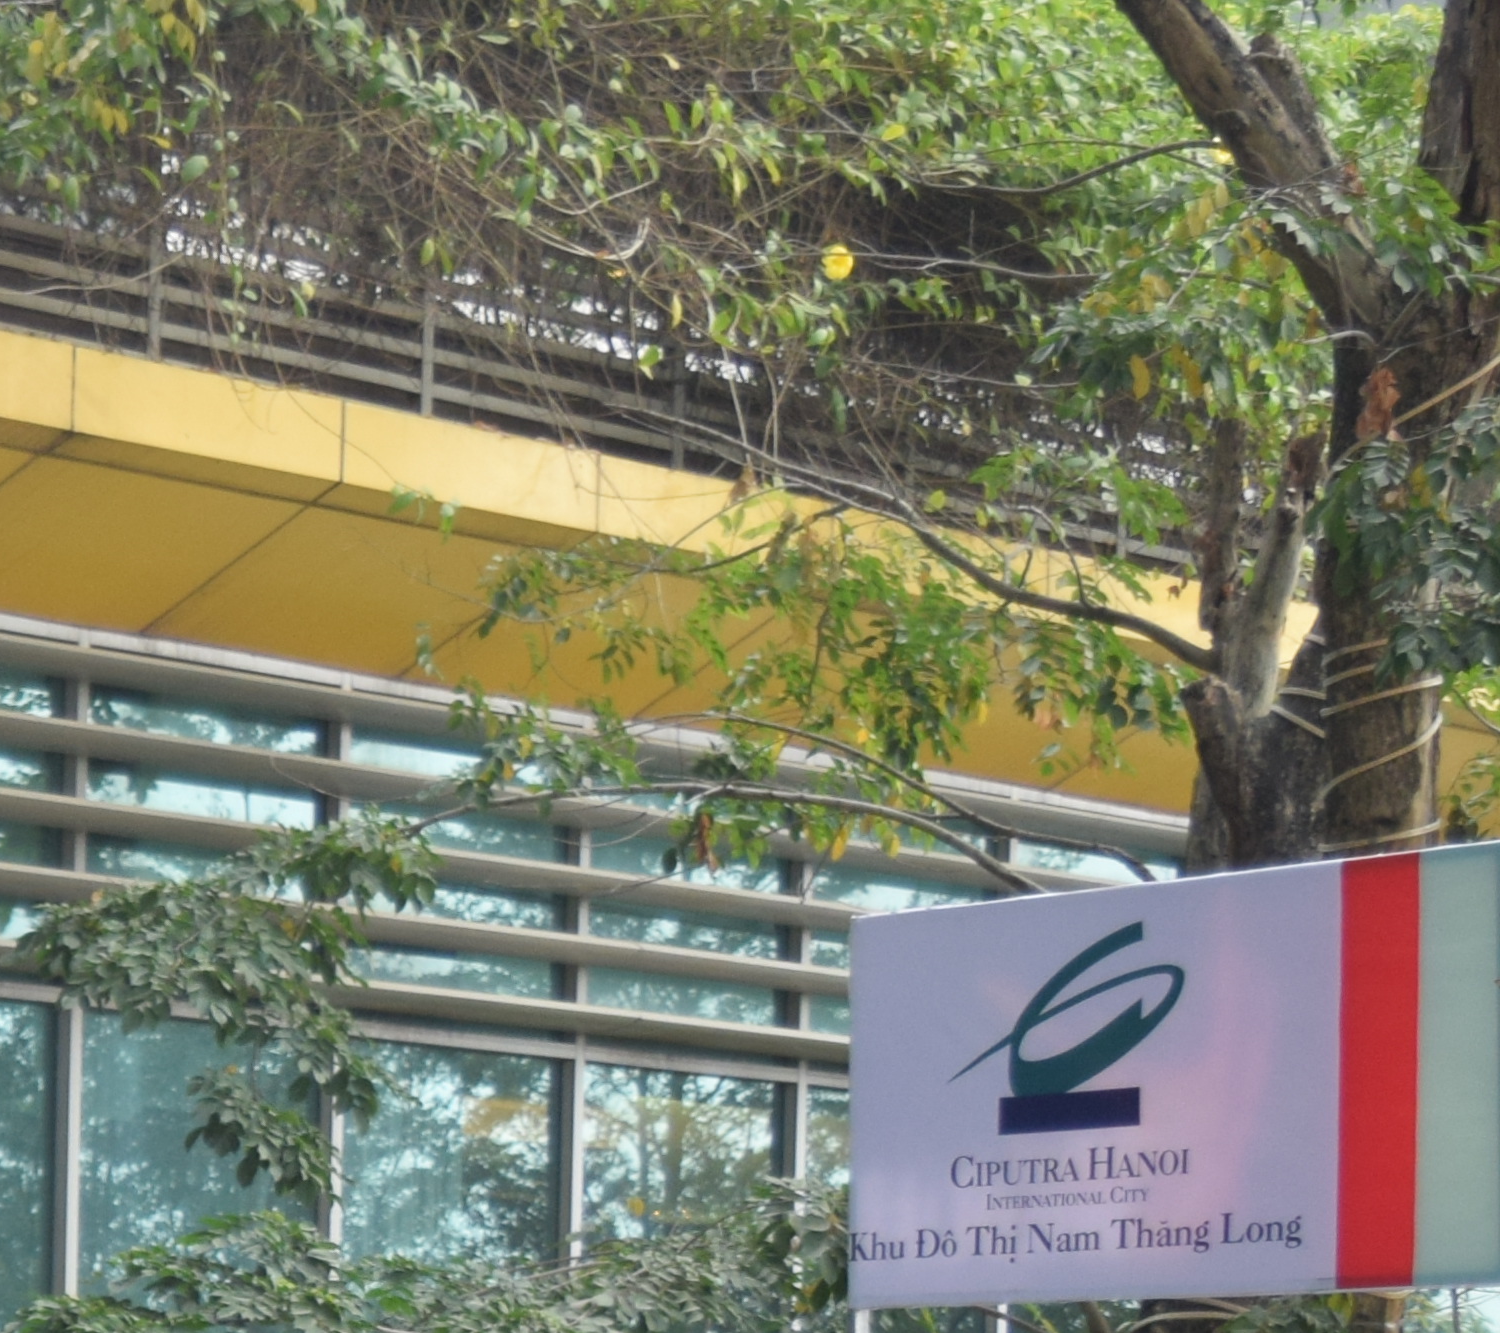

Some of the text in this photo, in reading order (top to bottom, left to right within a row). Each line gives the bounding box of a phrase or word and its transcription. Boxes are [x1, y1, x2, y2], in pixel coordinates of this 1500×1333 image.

[849, 1212, 1302, 1263] Khu Đô Thị Nam Thăng Long
